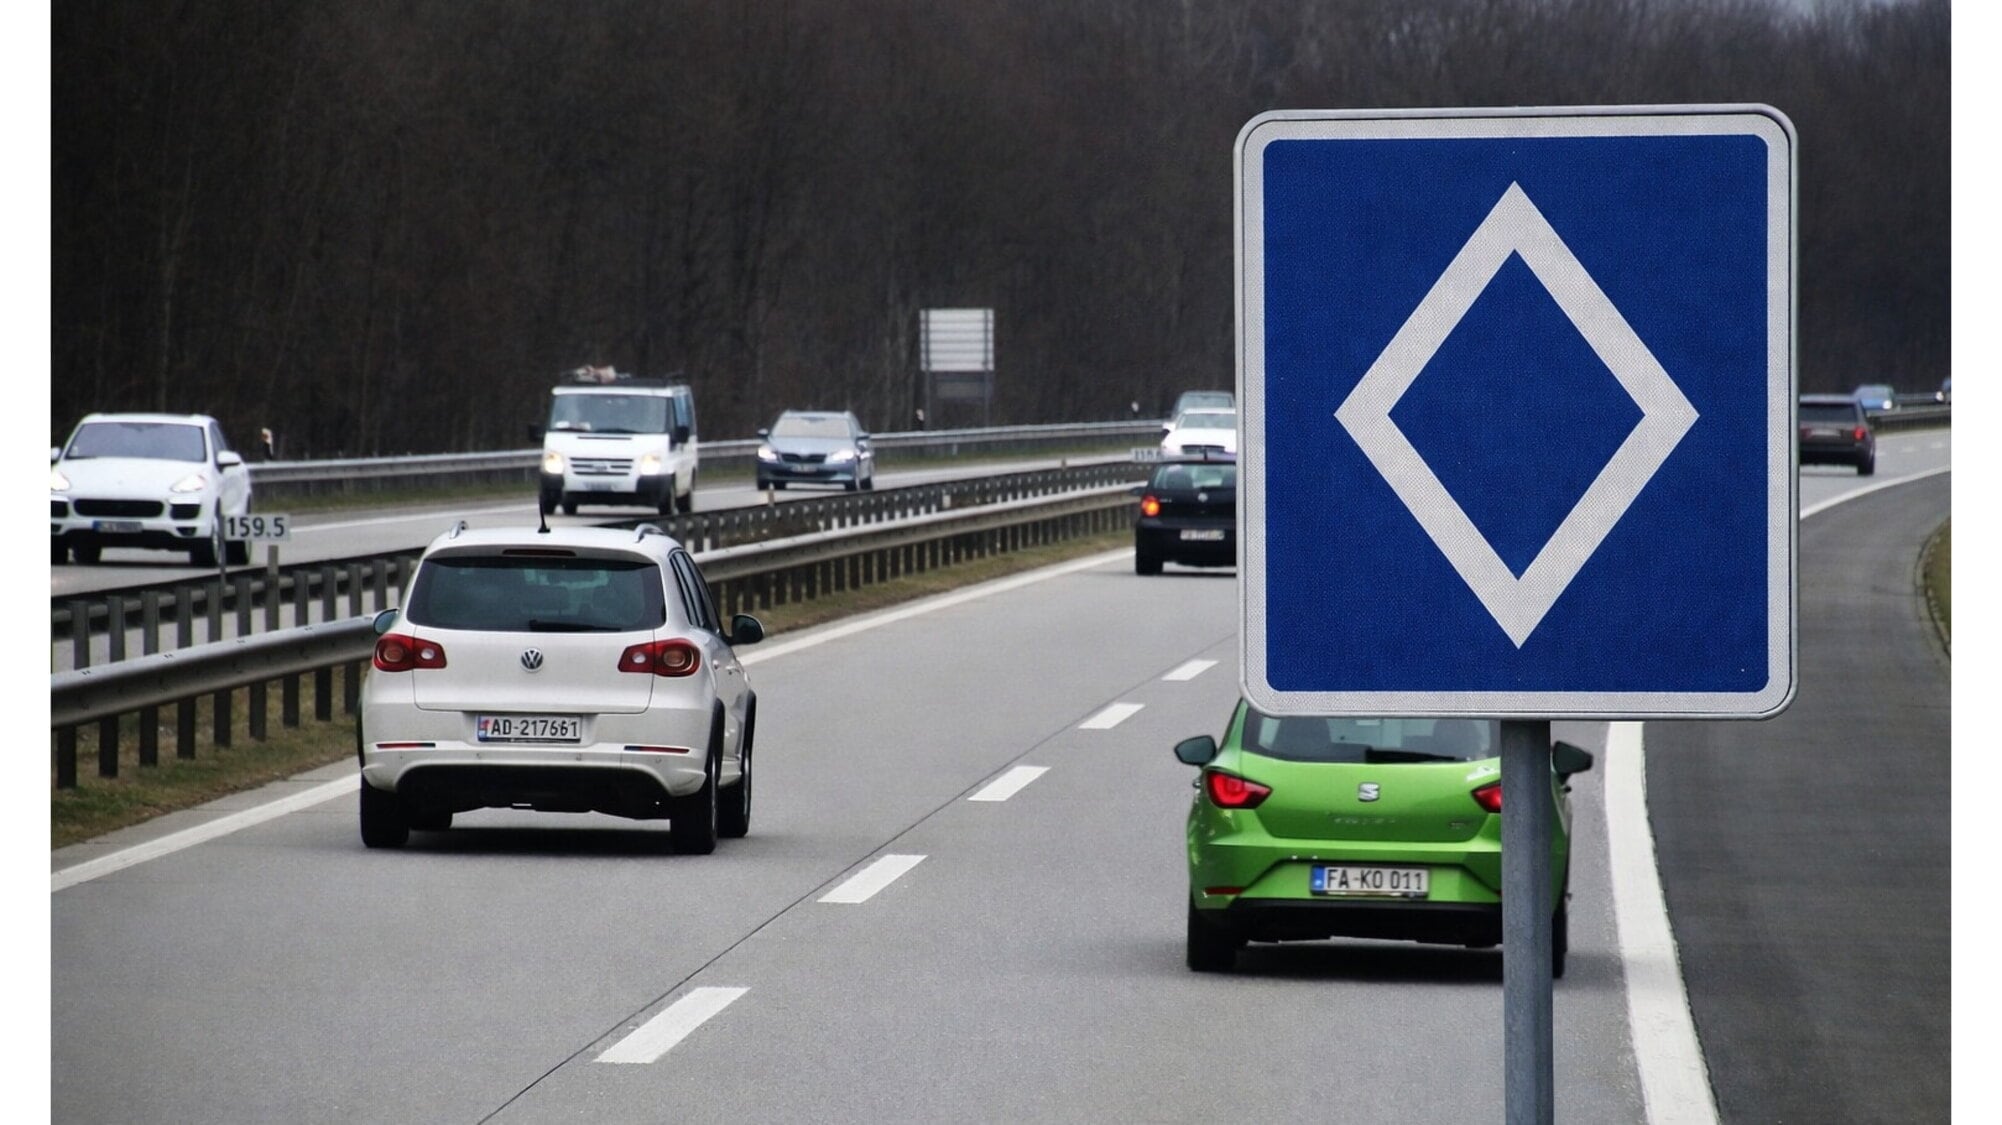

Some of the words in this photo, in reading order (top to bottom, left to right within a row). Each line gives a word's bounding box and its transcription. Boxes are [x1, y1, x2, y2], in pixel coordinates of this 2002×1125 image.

[228, 516, 285, 538] 159.5
[1327, 868, 1384, 889] FA-KO
[1390, 870, 1422, 890] 011
